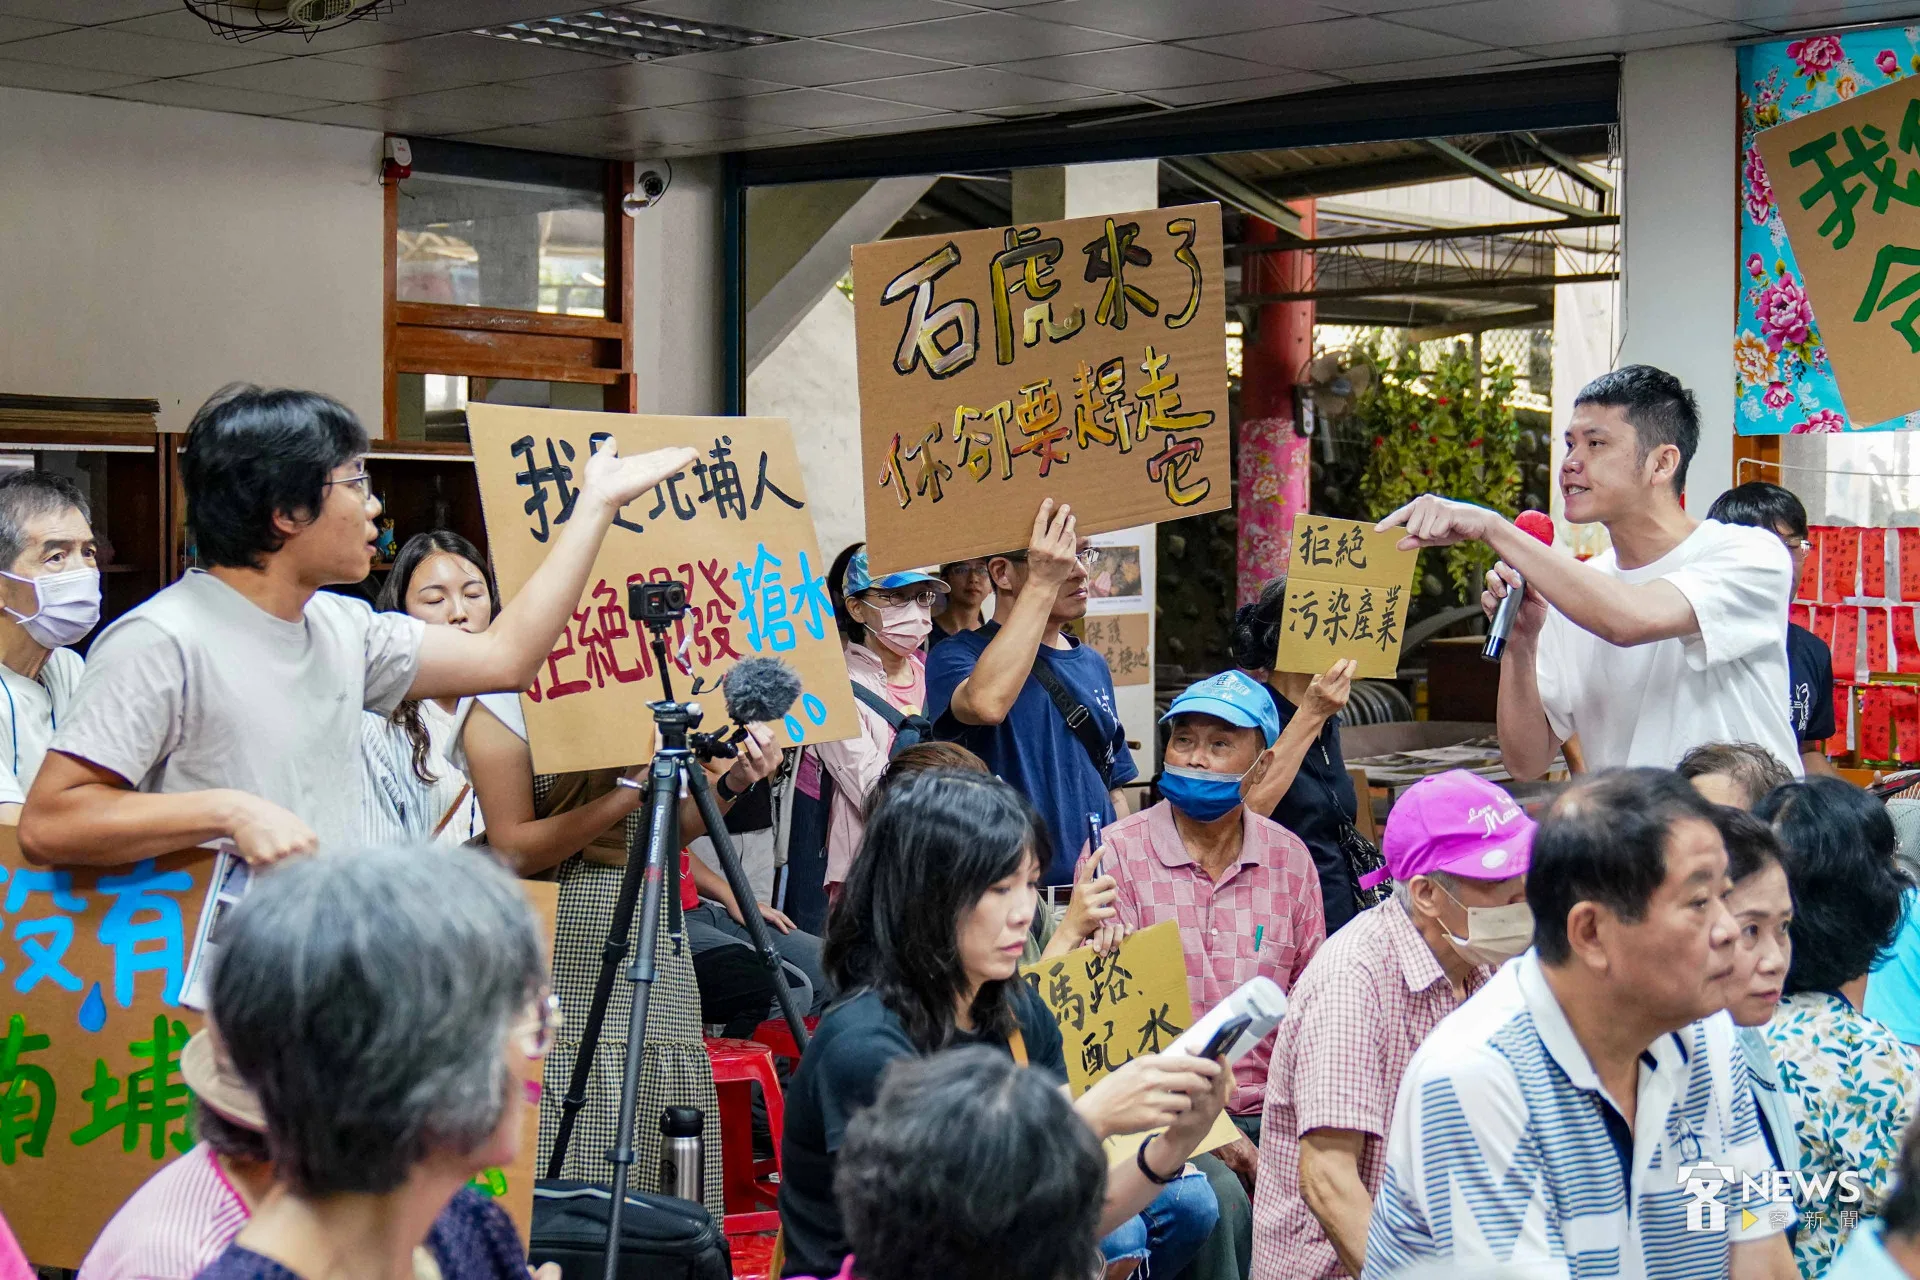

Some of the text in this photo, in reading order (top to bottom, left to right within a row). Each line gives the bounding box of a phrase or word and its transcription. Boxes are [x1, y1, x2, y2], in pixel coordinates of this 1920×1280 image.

[881, 218, 1203, 380] 石虎來了
[1298, 524, 1367, 570] 拒絕
[1289, 585, 1402, 652] 污染產業
[1081, 1003, 1184, 1077] 配水
